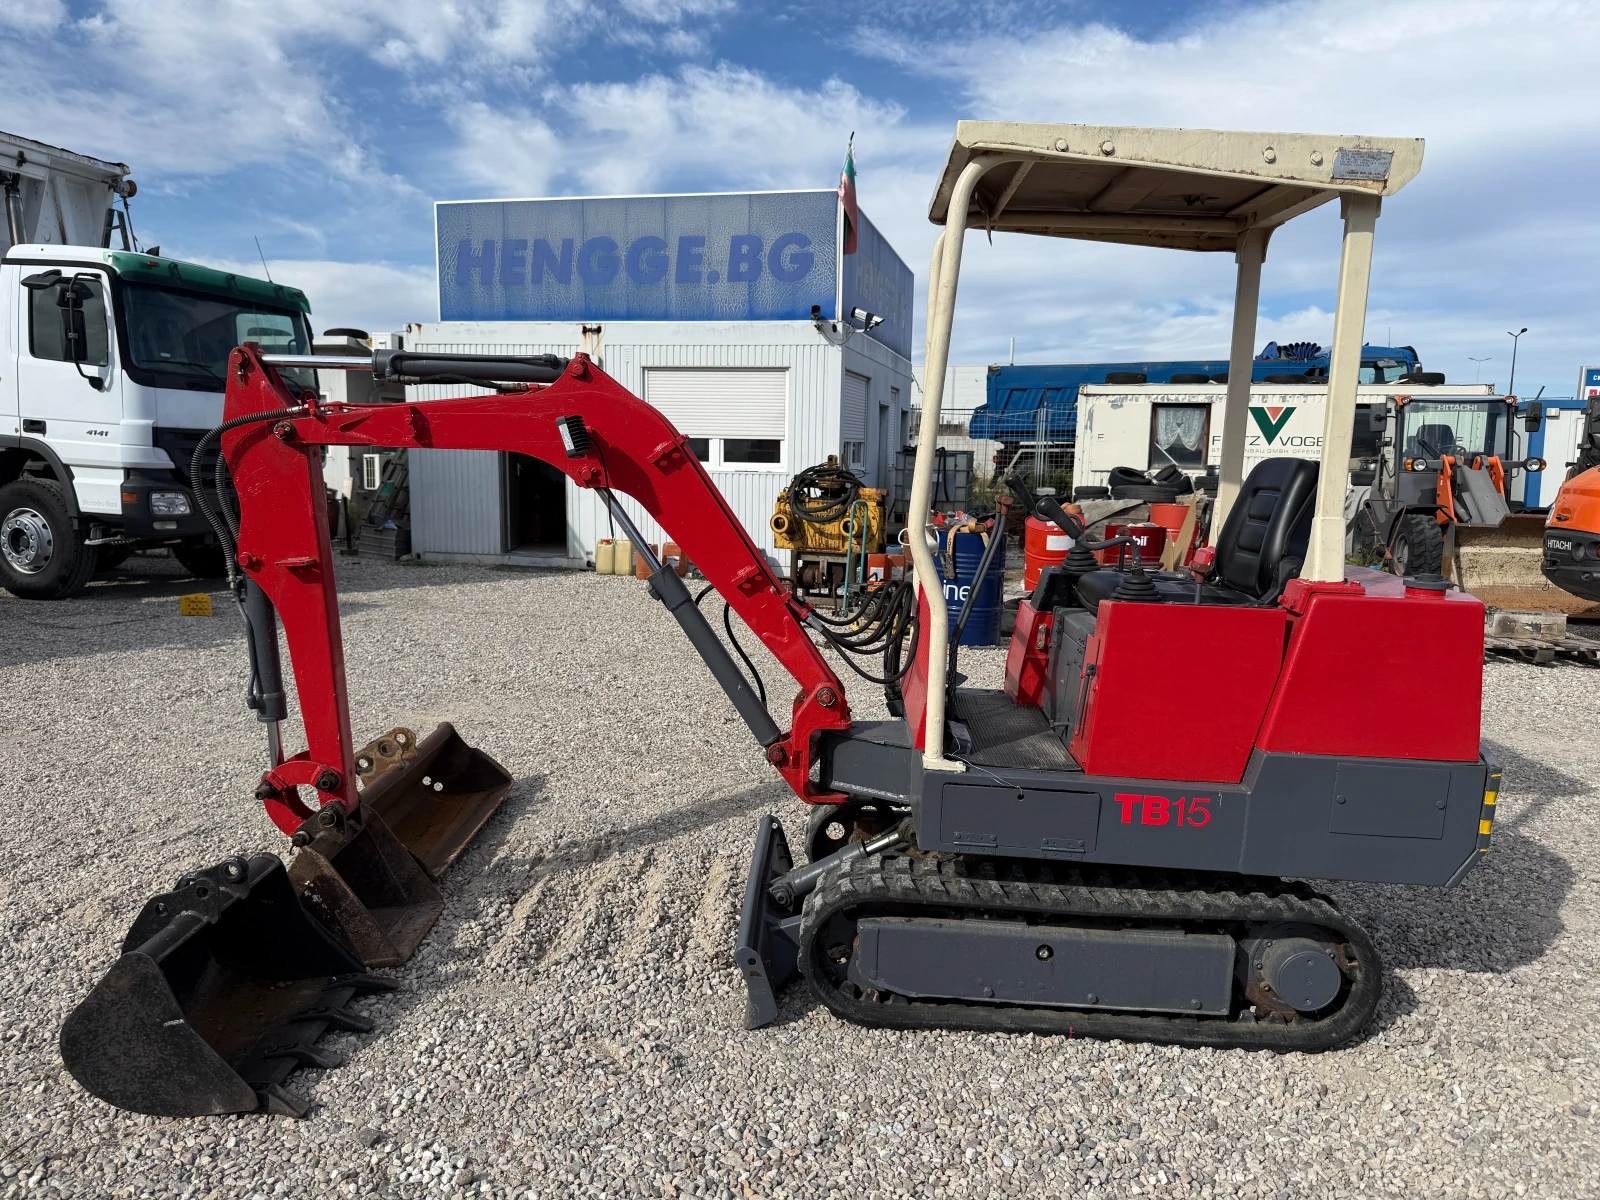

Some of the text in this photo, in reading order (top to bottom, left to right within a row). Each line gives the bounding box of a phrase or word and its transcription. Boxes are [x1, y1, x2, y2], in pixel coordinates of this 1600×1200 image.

[455, 232, 815, 286] HENGGE.BG
[86, 429, 109, 437] 4141
[1547, 538, 1572, 551] HITACHI
[1113, 793, 1212, 828] TB15
